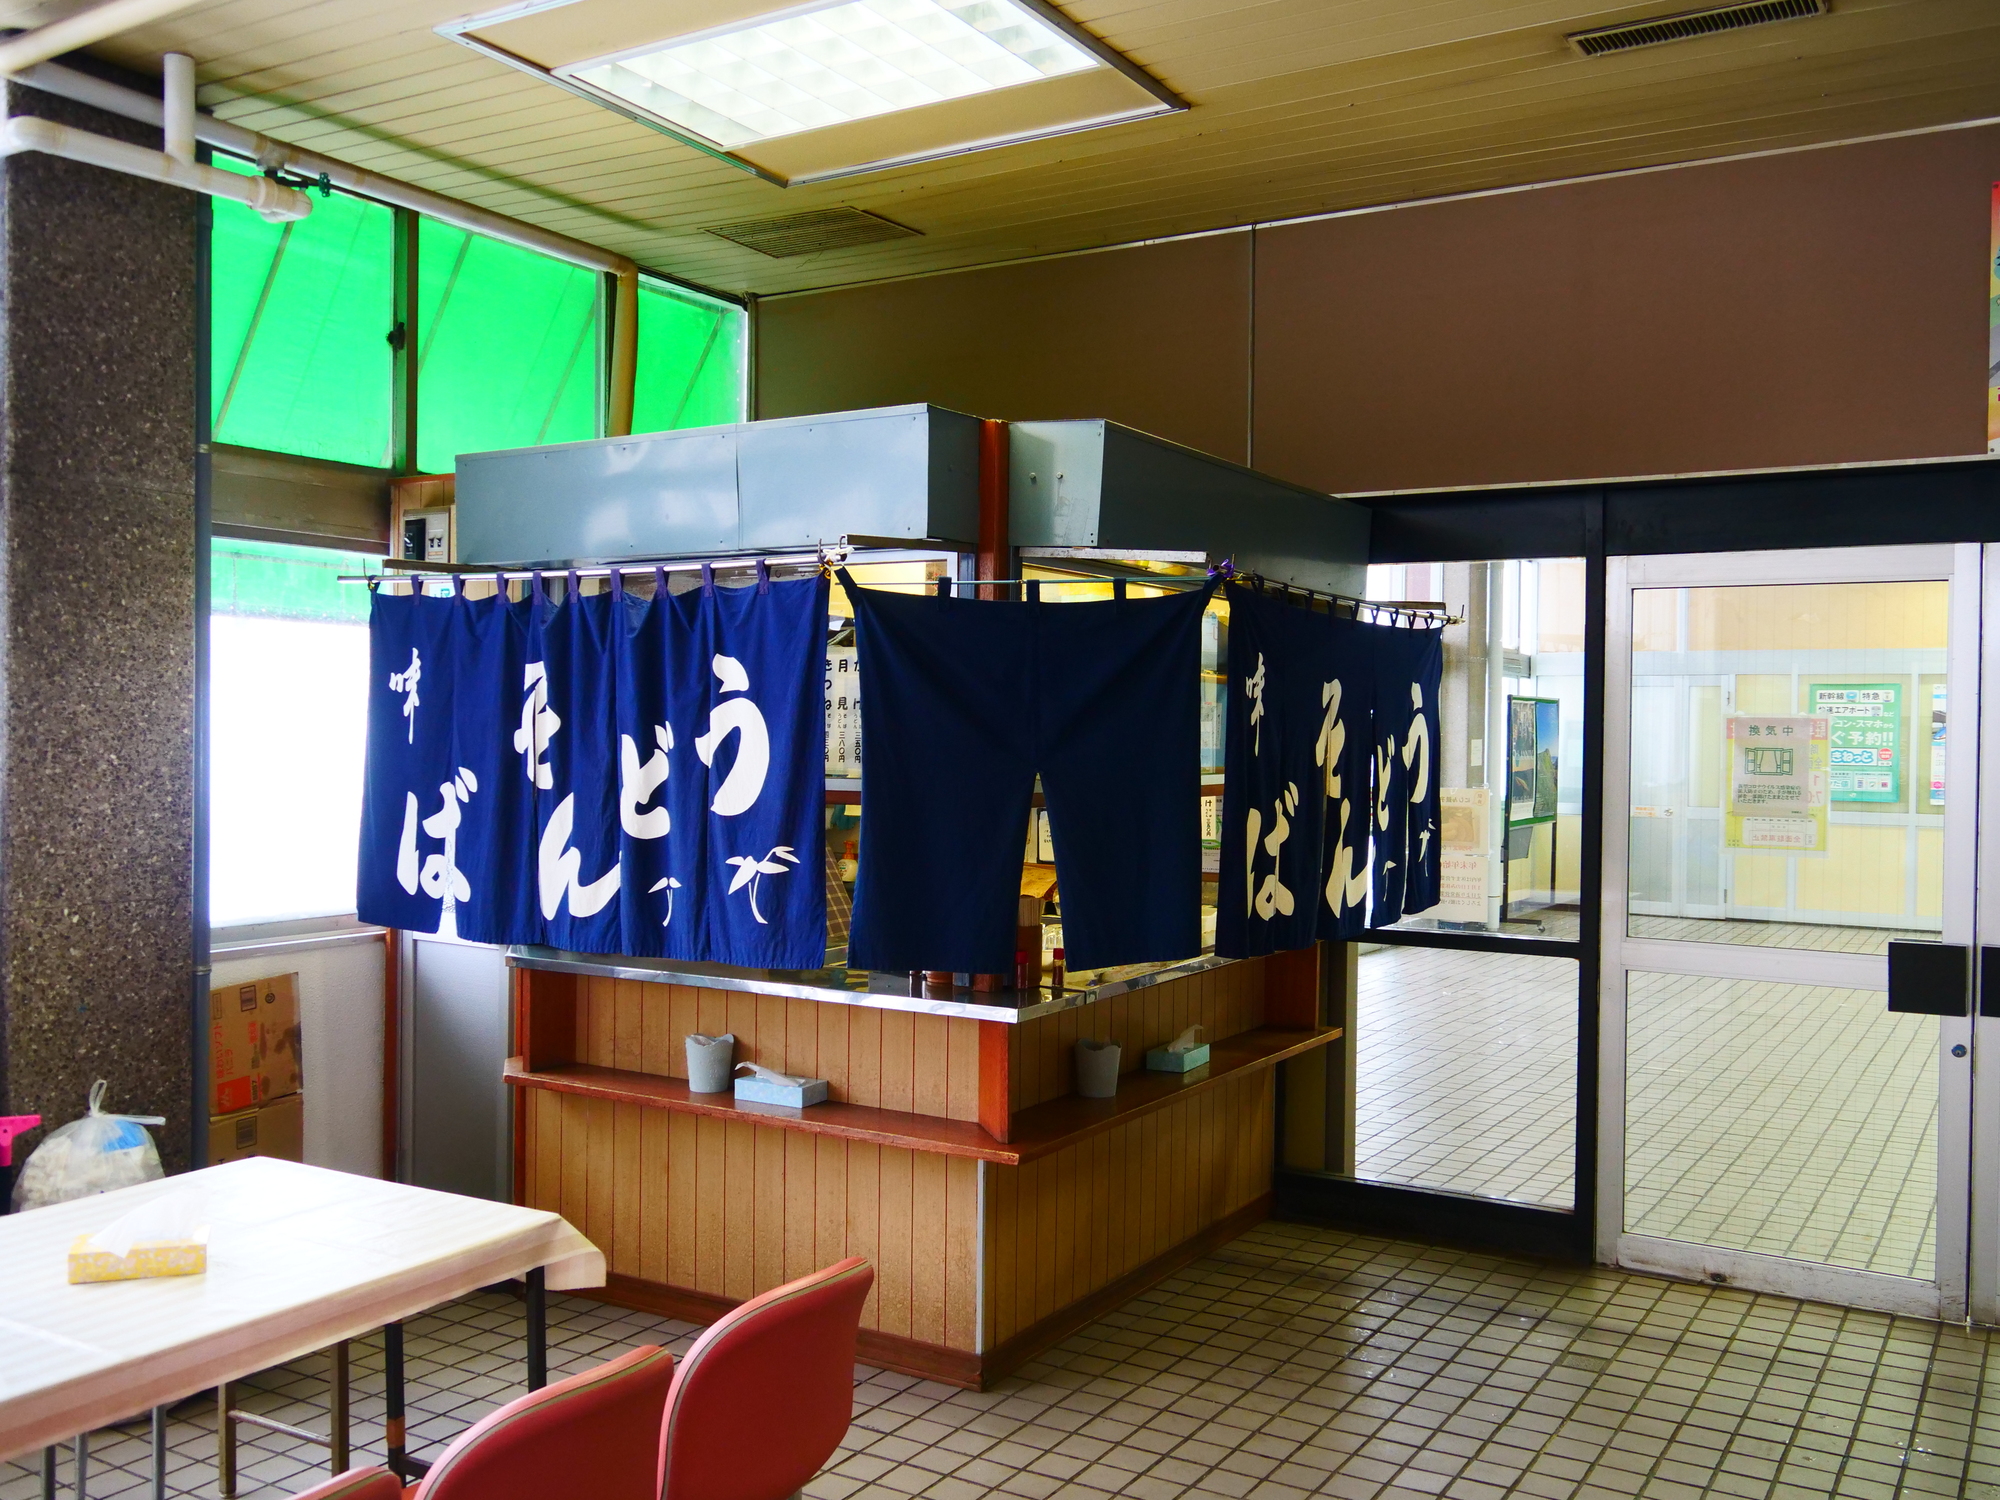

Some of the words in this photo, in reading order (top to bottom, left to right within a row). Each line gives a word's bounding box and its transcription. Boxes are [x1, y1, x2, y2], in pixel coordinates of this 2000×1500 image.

[837, 658, 848, 710] 月見
[389, 647, 422, 745] 味
[1819, 692, 1845, 700] 新幹線
[1862, 692, 1880, 700] 特急
[1749, 725, 1794, 737] 換気中
